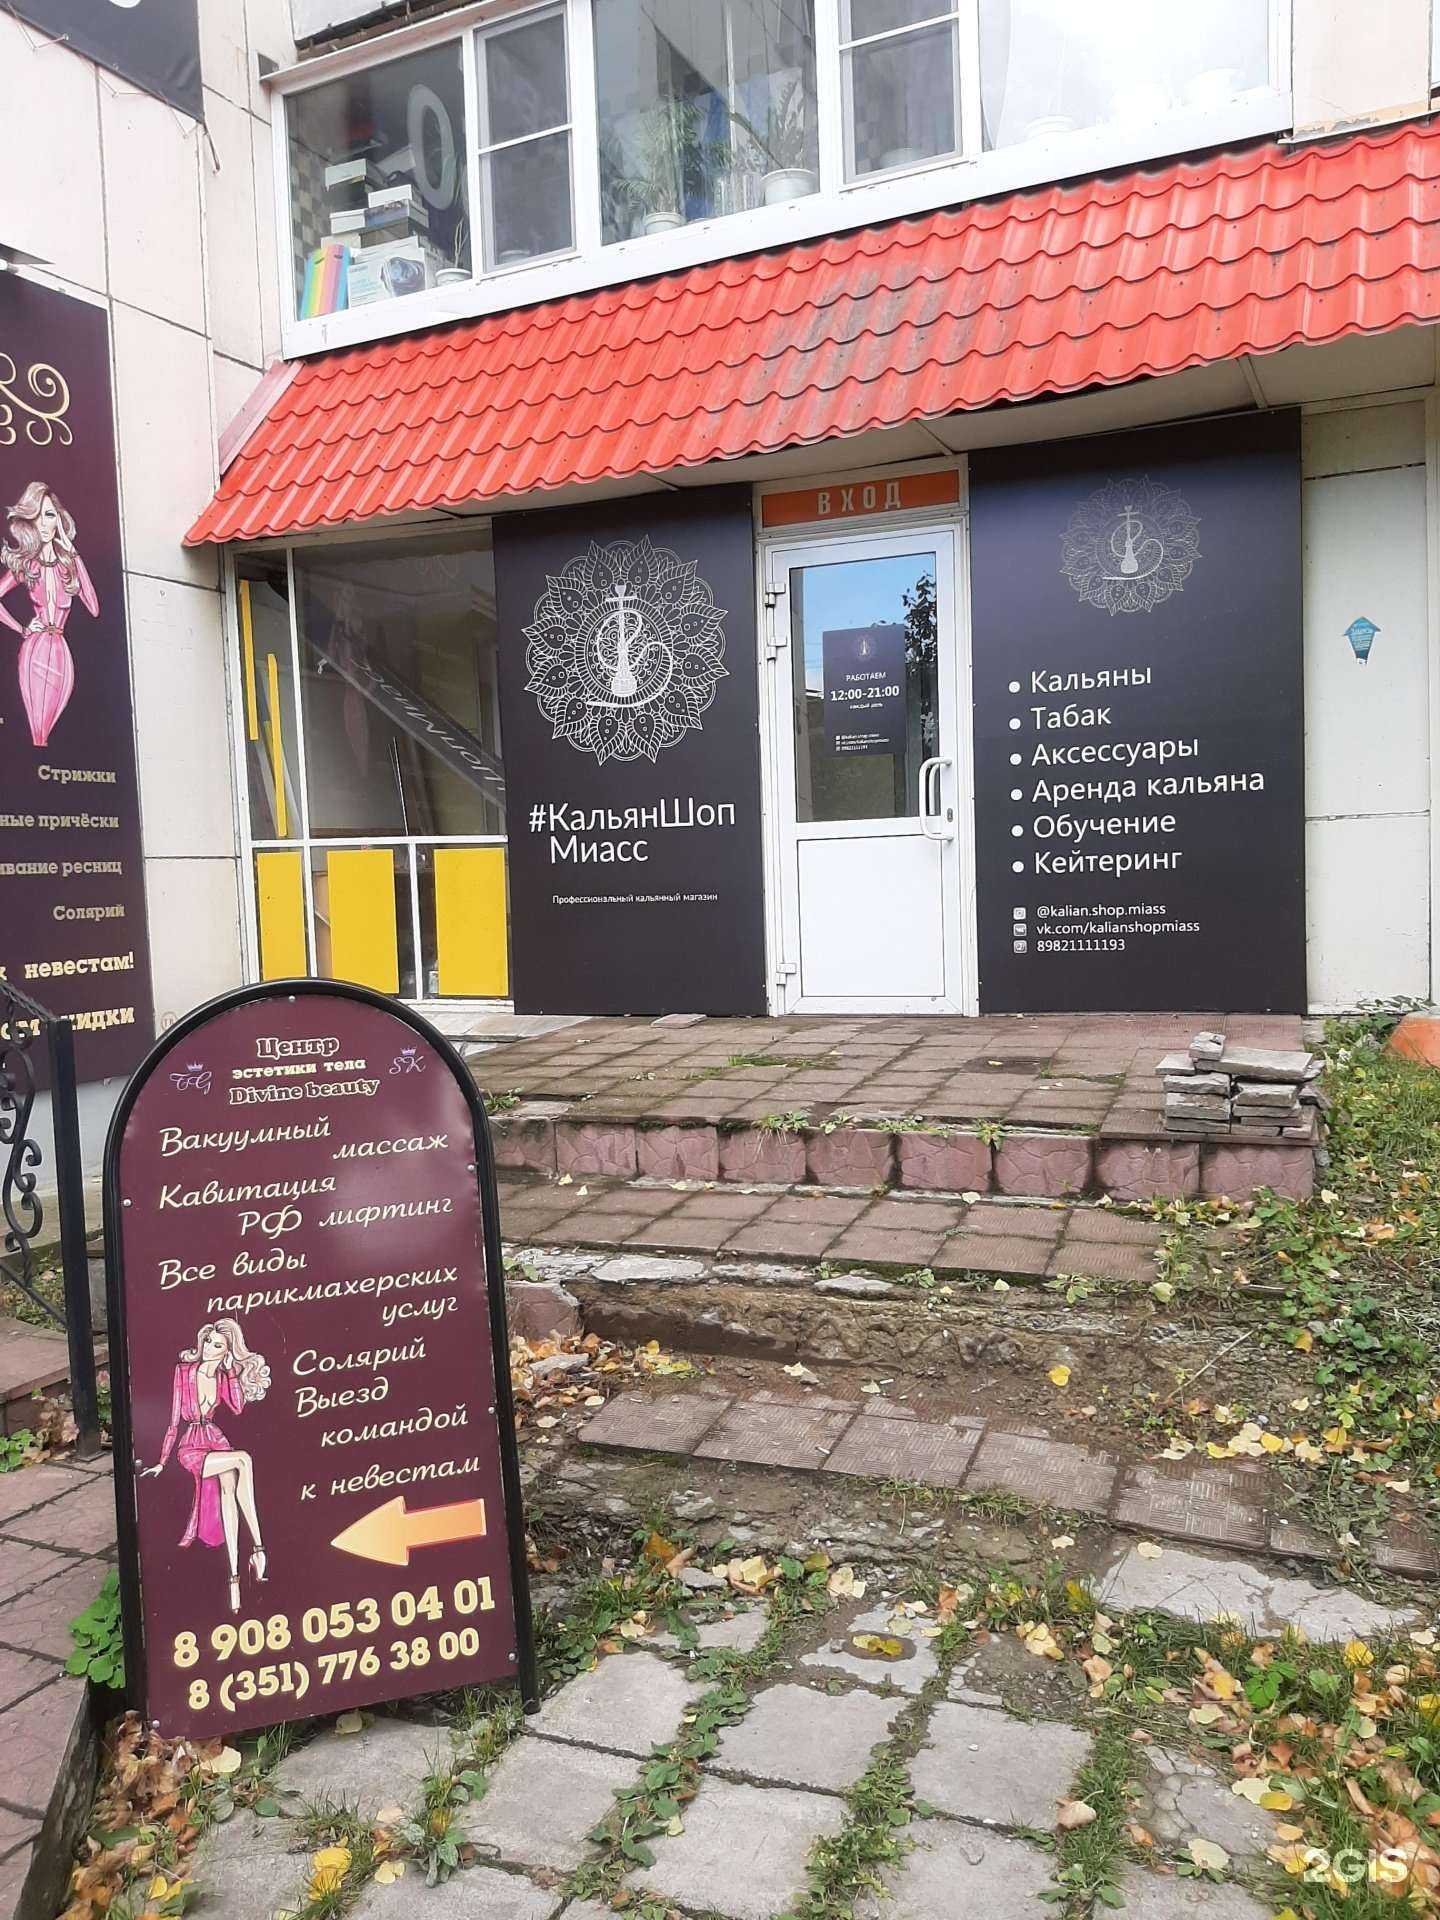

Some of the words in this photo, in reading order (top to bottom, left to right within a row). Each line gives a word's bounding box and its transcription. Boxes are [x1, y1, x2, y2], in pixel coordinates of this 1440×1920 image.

[817, 482, 901, 515] ВХОД
[846, 672, 887, 681] РАБОТАЕМ
[1031, 667, 1152, 693] Кальяны
[830, 685, 900, 701] 12:00-21:00
[1031, 704, 1112, 730] Табак
[1031, 738, 1199, 767] Аксессуары
[38, 765, 116, 784] Стрижки
[1032, 779, 1137, 808] Аренда
[1147, 772, 1265, 796] кальяна
[39, 813, 119, 830] причёски
[529, 797, 736, 833] #КальянШоп
[1033, 813, 1177, 843] Обучение
[550, 834, 649, 864] Миасс
[1034, 849, 1183, 878] Кейтеринг
[62, 861, 122, 877] ресниц
[53, 904, 126, 921] Солярий
[552, 894, 634, 904] Профессиональный
[635, 892, 682, 902] кальянный
[683, 893, 718, 902] магазин
[1037, 903, 1167, 919] @kalian.shop.miass
[1036, 920, 1200, 936] vk.com/kalianshopmiass
[1037, 938, 1126, 952] 89821111193
[24, 951, 135, 979] невестам!
[256, 1037, 341, 1060] Центр
[232, 1063, 317, 1080] эстетики
[323, 1059, 367, 1072] тела
[229, 1084, 303, 1105] Divine
[305, 1078, 380, 1098] beauty
[159, 1115, 332, 1157] Вакуумный
[332, 1131, 449, 1161] массаж
[159, 1176, 336, 1209] Кавитация
[238, 1203, 303, 1239] РФ
[319, 1197, 453, 1228] лифтинг
[158, 1258, 216, 1291] Все
[232, 1248, 308, 1276] виды
[207, 1265, 458, 1314] парикмахерских
[382, 1295, 458, 1327] услуг
[292, 1336, 427, 1376] Солярий
[295, 1376, 389, 1418] Выезд
[320, 1403, 469, 1448] командой
[300, 1483, 317, 1501] к
[330, 1456, 480, 1496] невестам
[173, 1630, 200, 1668] 8
[210, 1614, 292, 1661] 908
[302, 1596, 381, 1643] 053
[391, 1586, 444, 1626] 04
[454, 1575, 496, 1615] 01
[188, 1679, 210, 1710] 8
[219, 1660, 310, 1712] (351)
[318, 1646, 381, 1685] 776
[389, 1637, 431, 1671] 38
[439, 1627, 480, 1660] 00
